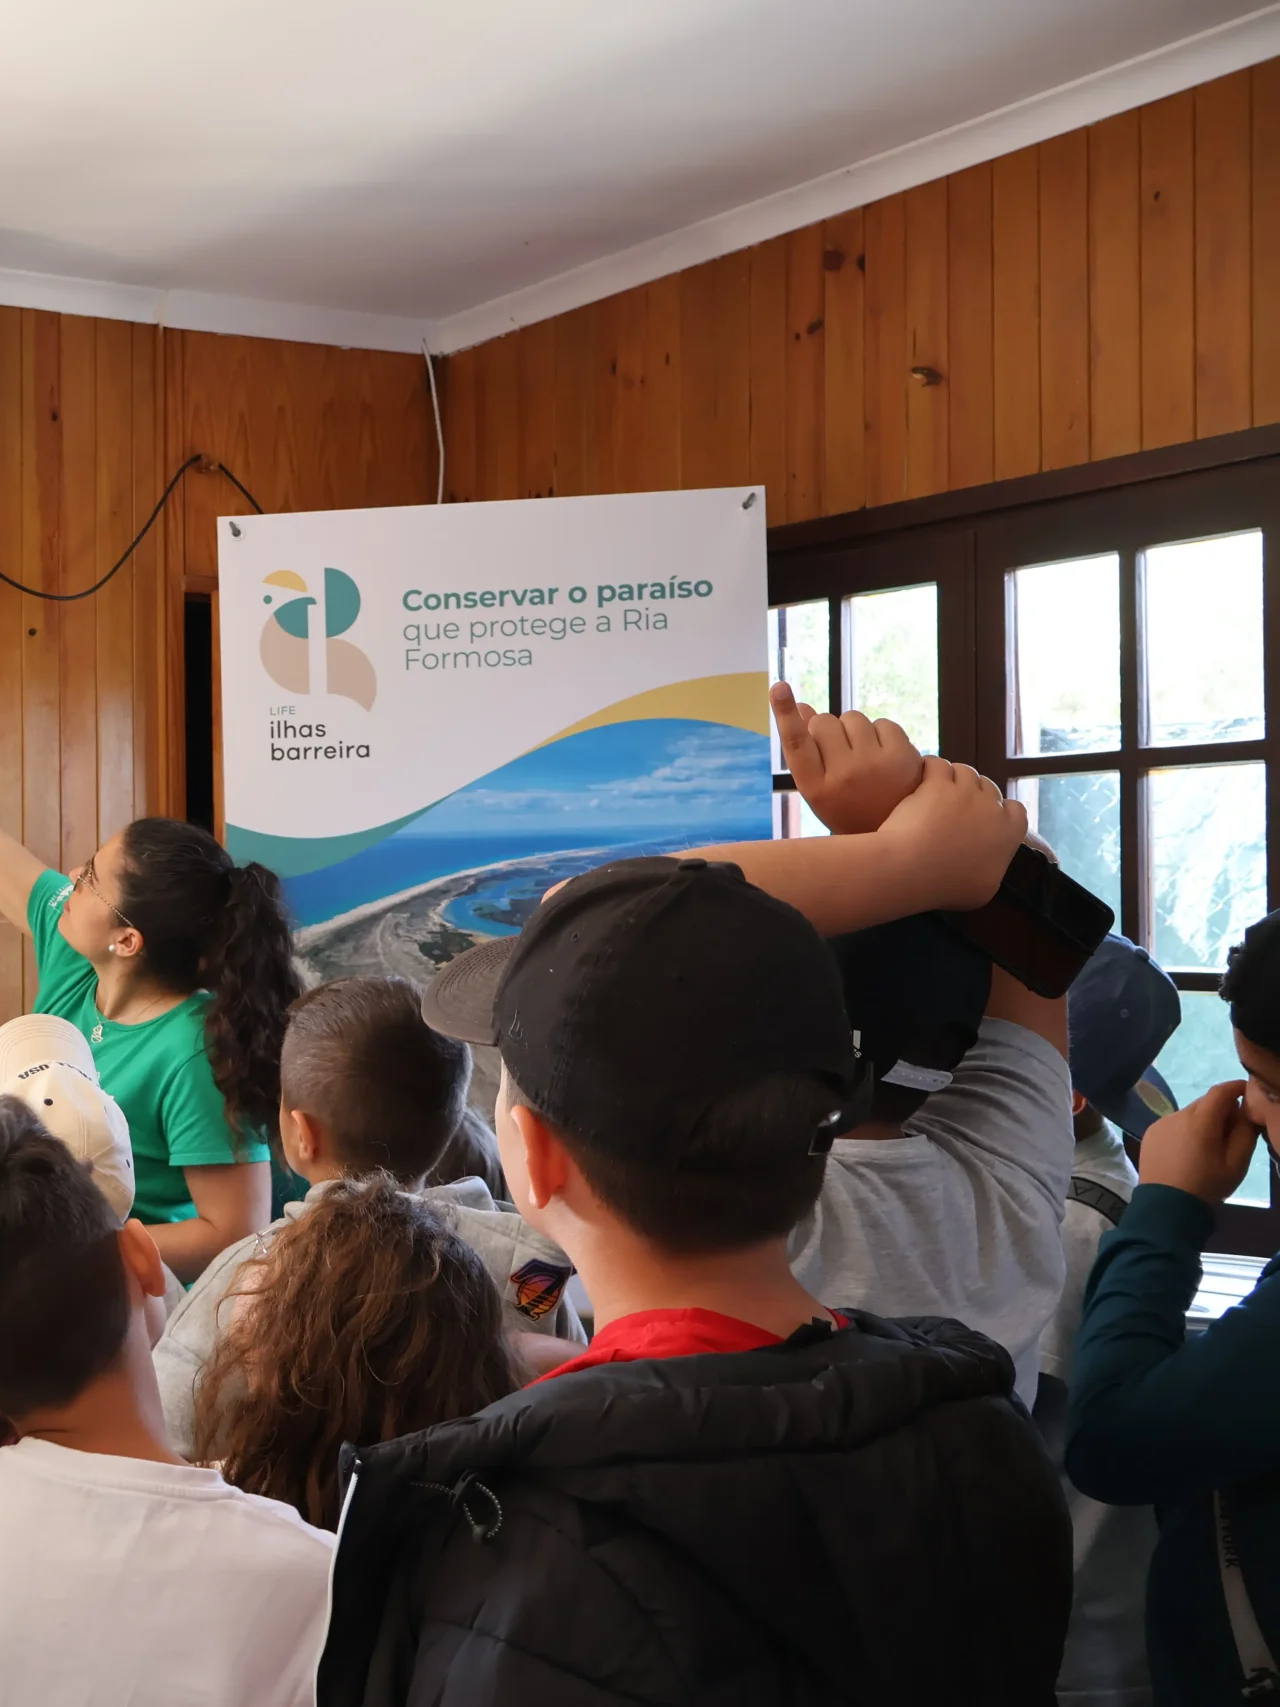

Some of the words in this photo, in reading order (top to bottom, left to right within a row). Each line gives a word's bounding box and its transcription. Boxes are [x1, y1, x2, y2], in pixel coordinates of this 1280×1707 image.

[402, 587, 560, 612] Conservar
[567, 586, 588, 604] o
[597, 574, 714, 609] paraíso
[403, 622, 460, 646] que
[470, 615, 587, 644] protege
[595, 615, 611, 633] a
[623, 607, 668, 632] Ria
[405, 648, 533, 671] Formosa
[269, 705, 296, 716] LIFE
[270, 719, 327, 740] ilhas
[270, 742, 371, 762] barreira
[17, 1063, 50, 1080] USA
